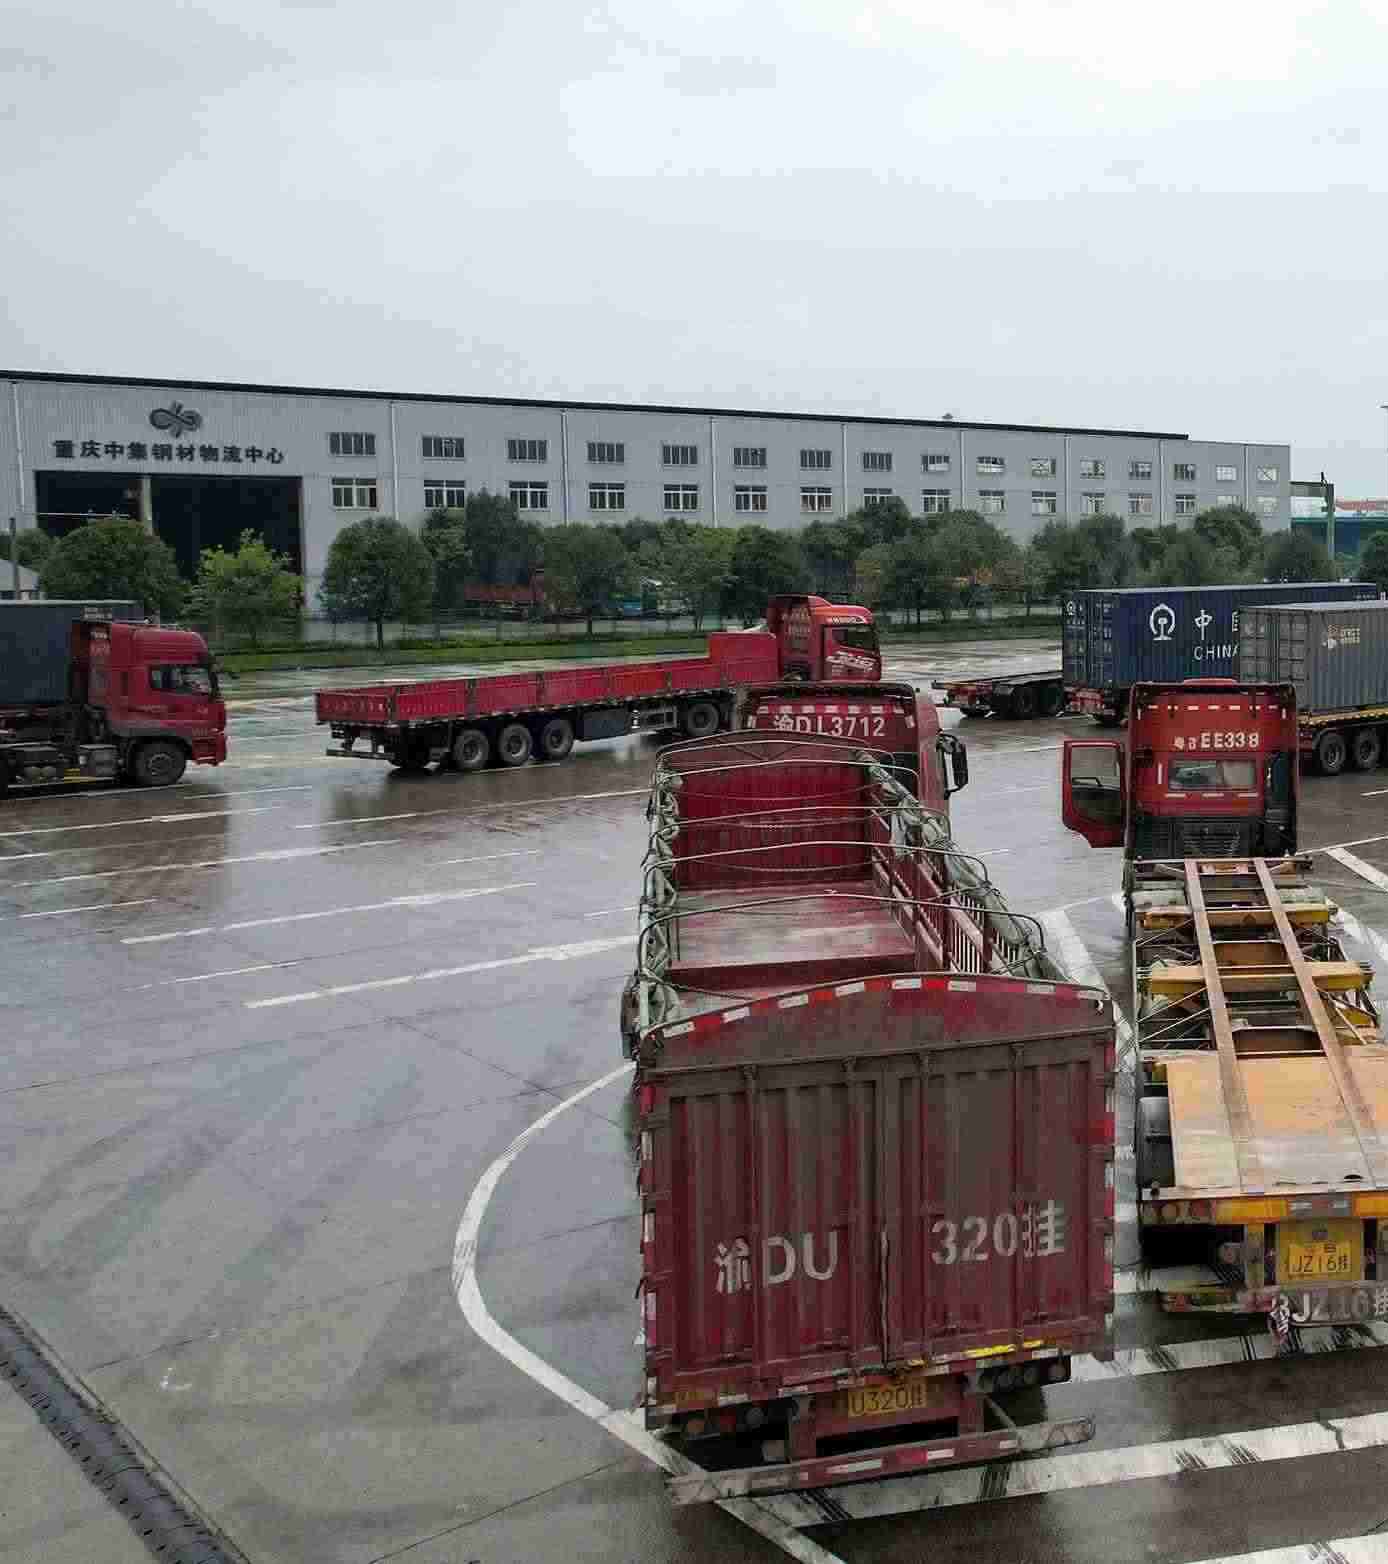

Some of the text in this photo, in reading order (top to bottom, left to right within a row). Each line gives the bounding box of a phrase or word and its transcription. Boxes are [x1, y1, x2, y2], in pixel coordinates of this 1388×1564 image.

[53, 439, 285, 465] 重庆中集钢材物流中心
[714, 1198, 1066, 1295] 渝DU 320挂
